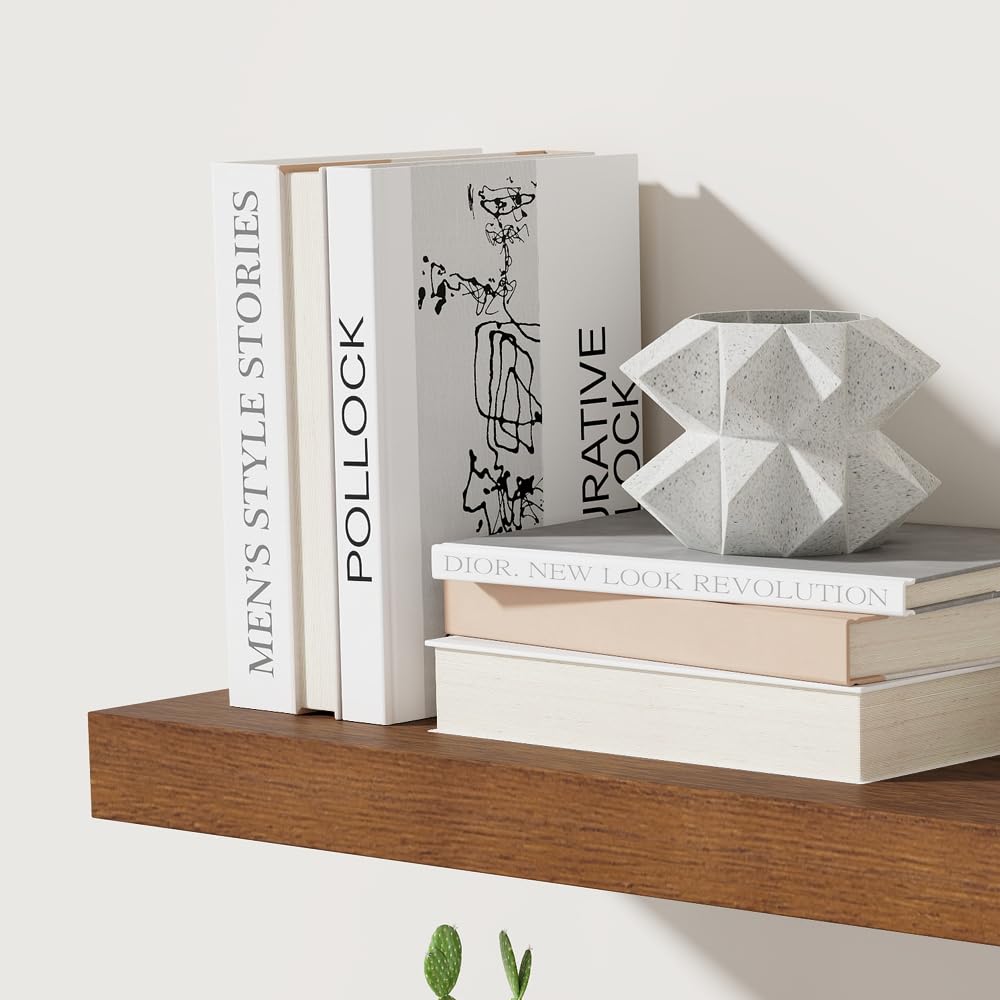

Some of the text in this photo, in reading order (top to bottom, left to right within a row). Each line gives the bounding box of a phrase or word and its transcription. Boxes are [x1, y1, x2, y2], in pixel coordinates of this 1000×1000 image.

[233, 190, 265, 379] STORIES
[240, 392, 270, 530] STYLE
[339, 316, 373, 583] POLLOCK
[444, 555, 889, 607] DIOR. NEW LOOK REVOLUTION
